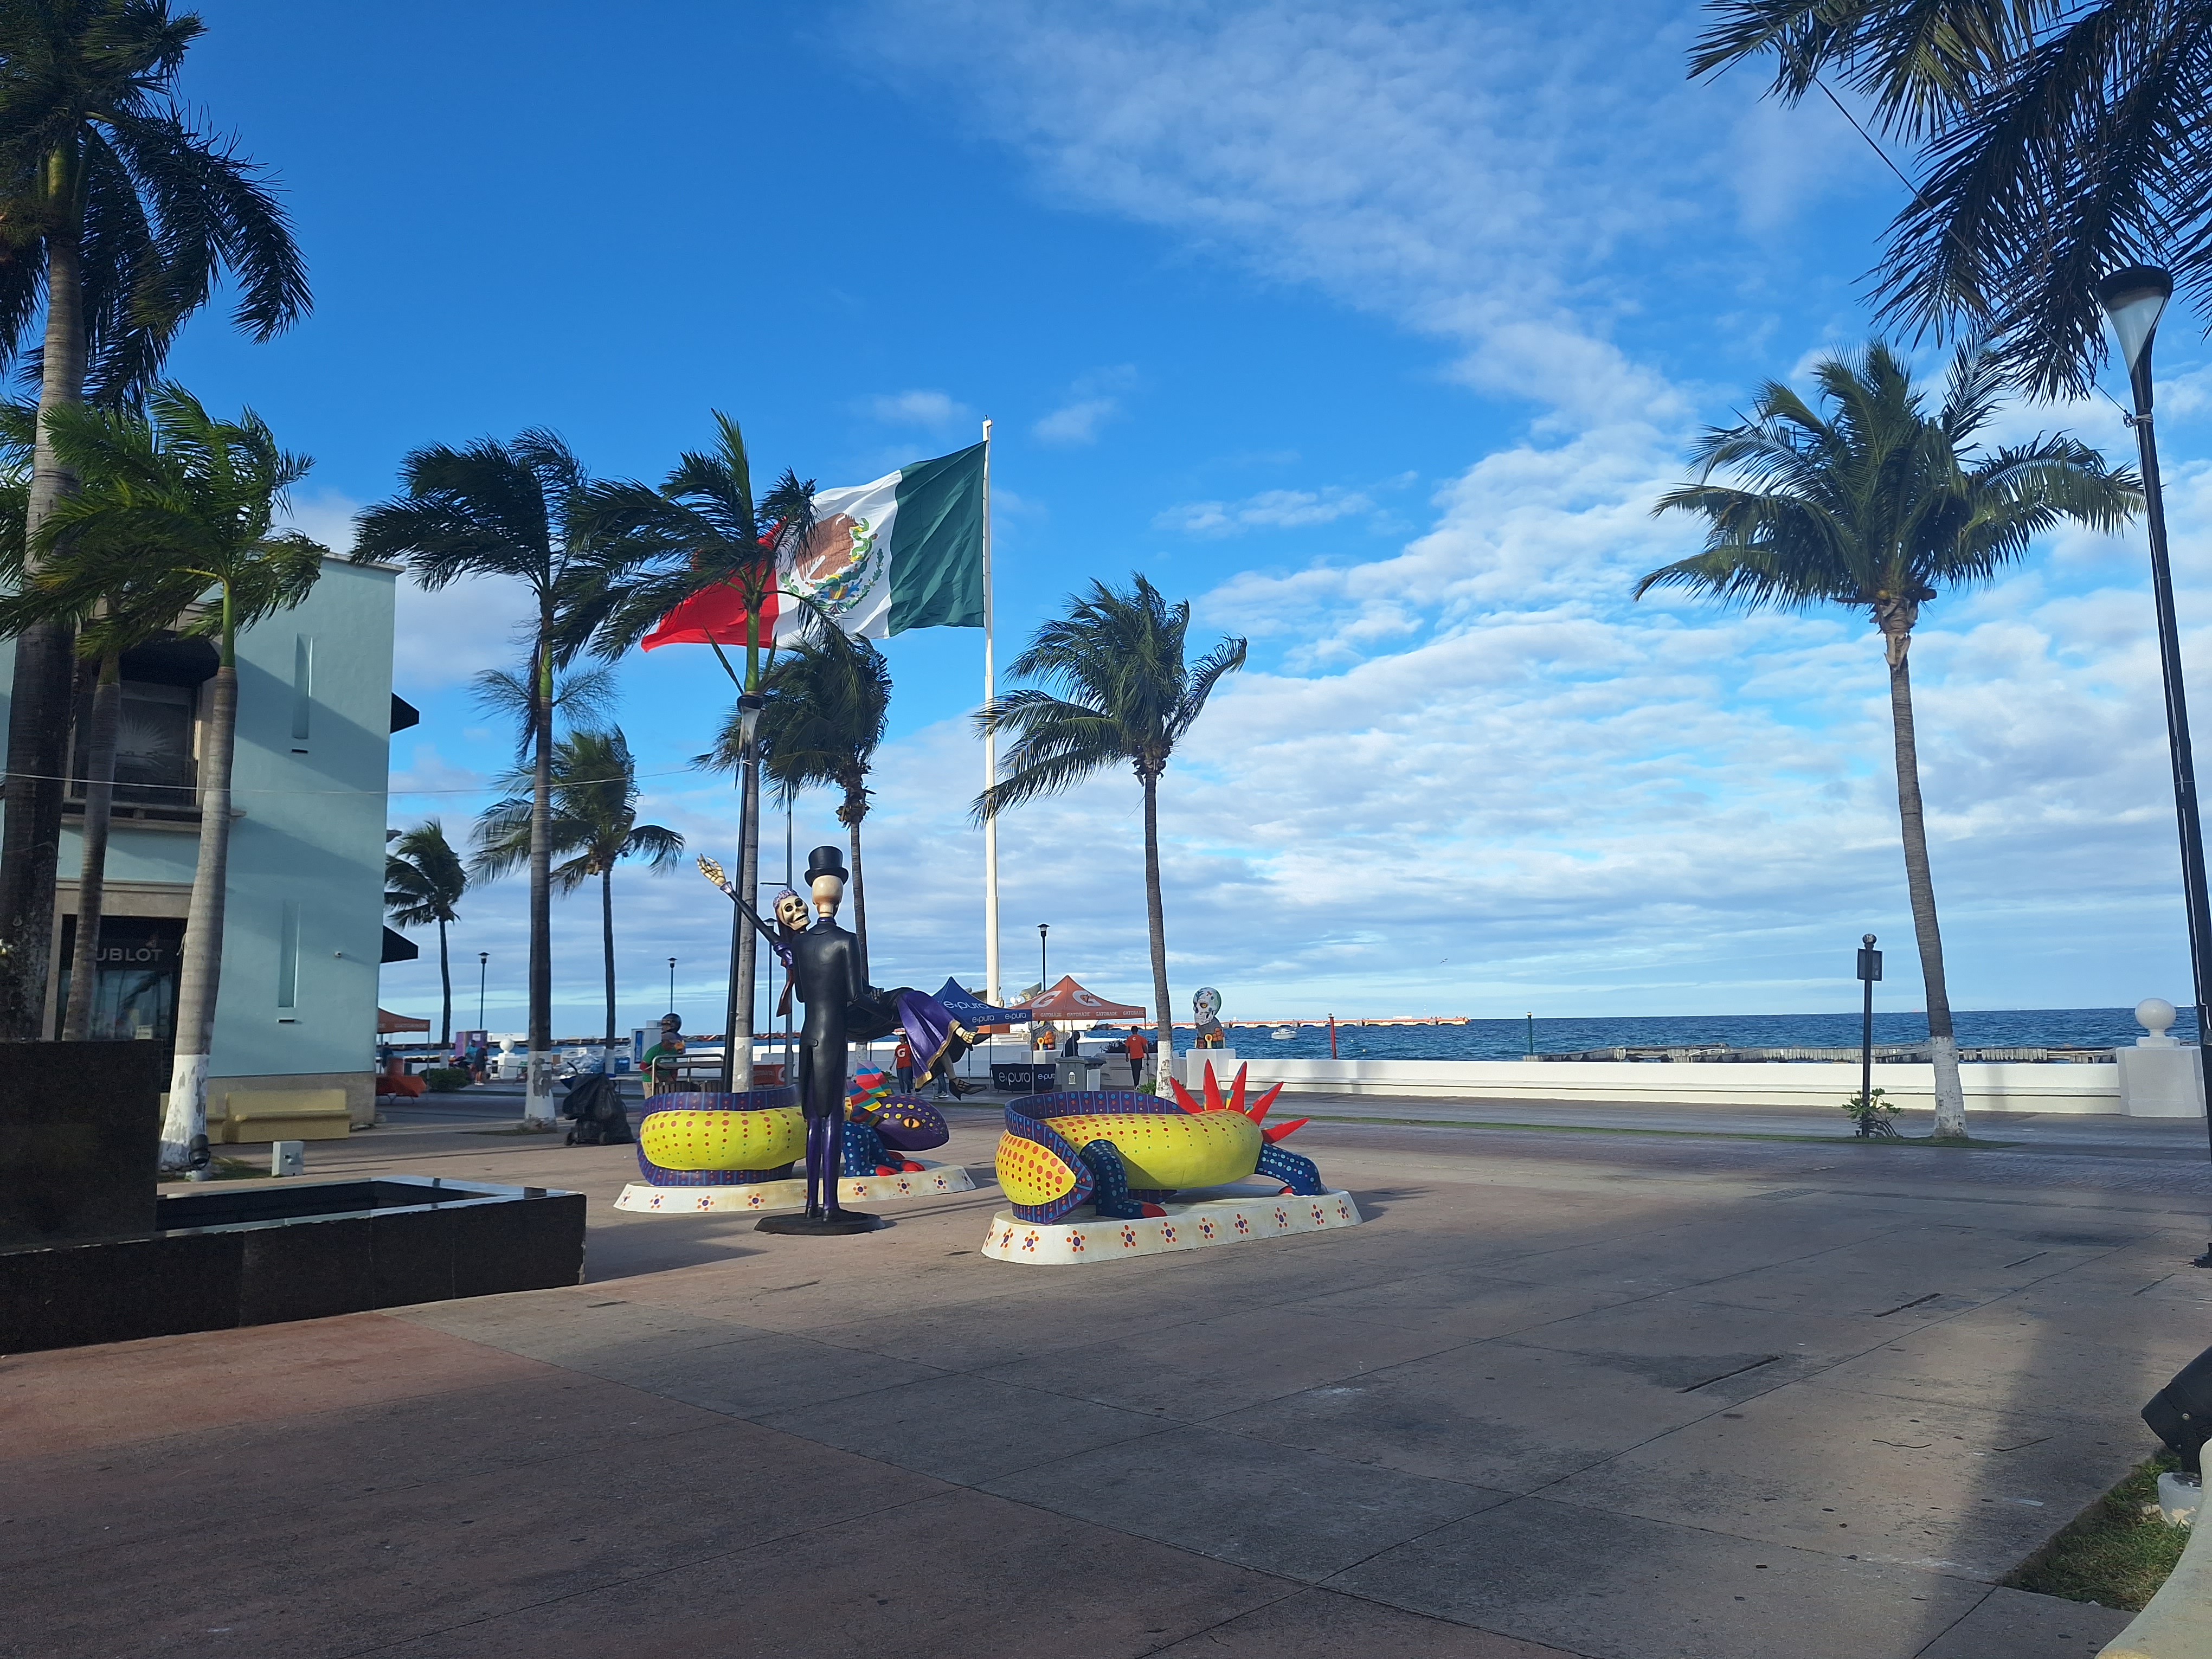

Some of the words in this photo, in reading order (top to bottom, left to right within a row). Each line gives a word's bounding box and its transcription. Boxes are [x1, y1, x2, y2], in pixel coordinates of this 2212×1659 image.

[96, 948, 163, 962] UBLOT
[1072, 990, 1102, 1007] G
[897, 1048, 905, 1058] G
